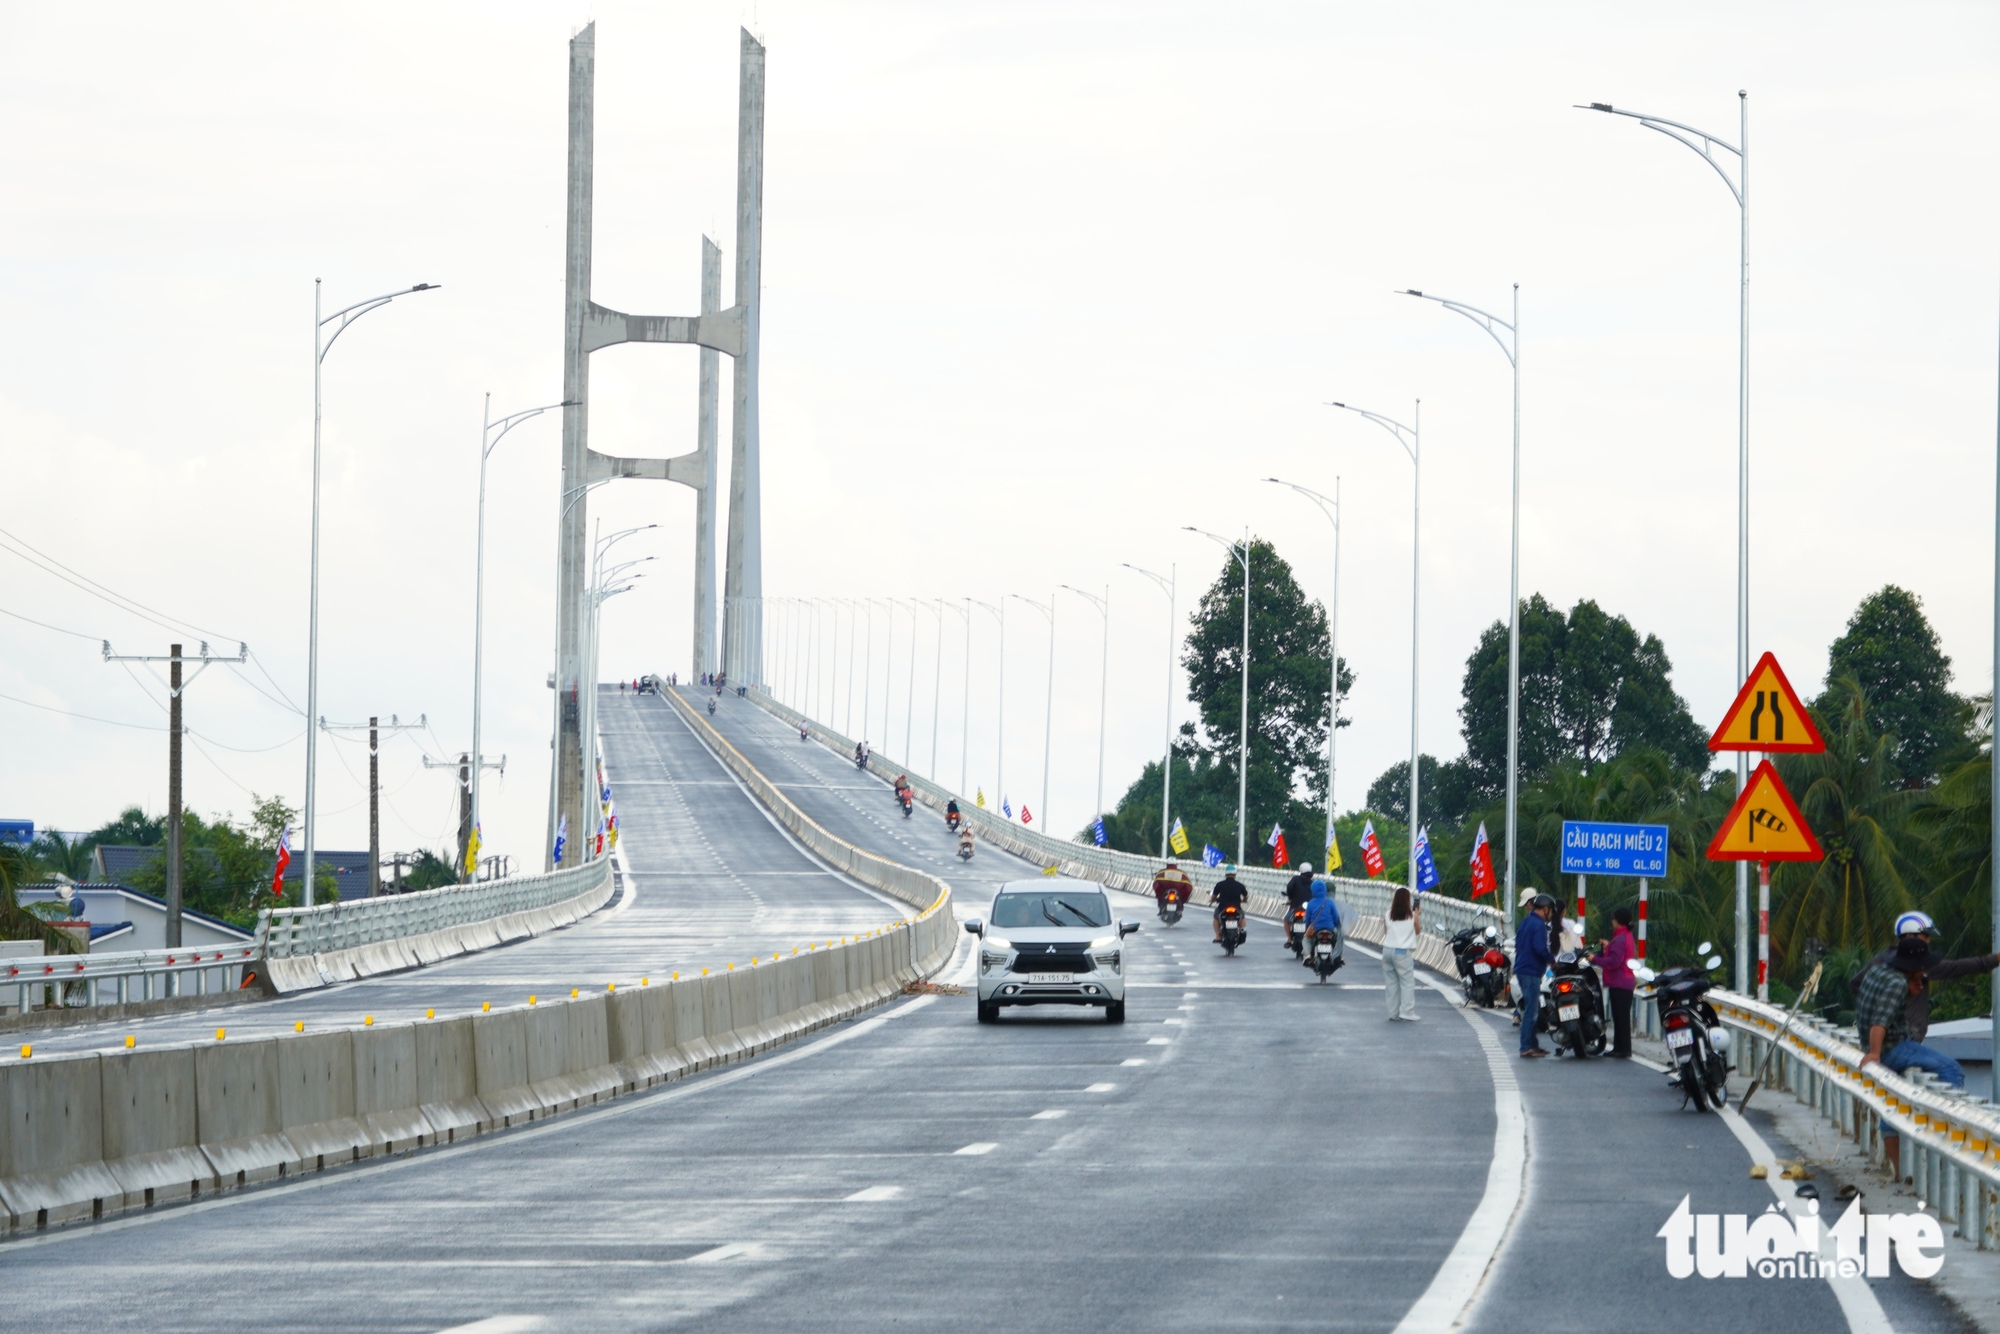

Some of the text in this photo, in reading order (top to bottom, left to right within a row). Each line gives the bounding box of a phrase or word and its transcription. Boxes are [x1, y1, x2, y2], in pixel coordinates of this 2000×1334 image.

[1567, 826, 1589, 848] CẦU
[1592, 832, 1622, 851] RẠCH
[1655, 835, 1663, 852] 2
[1566, 857, 1620, 869] Km 6 + 168
[1633, 859, 1662, 871] QL.60
